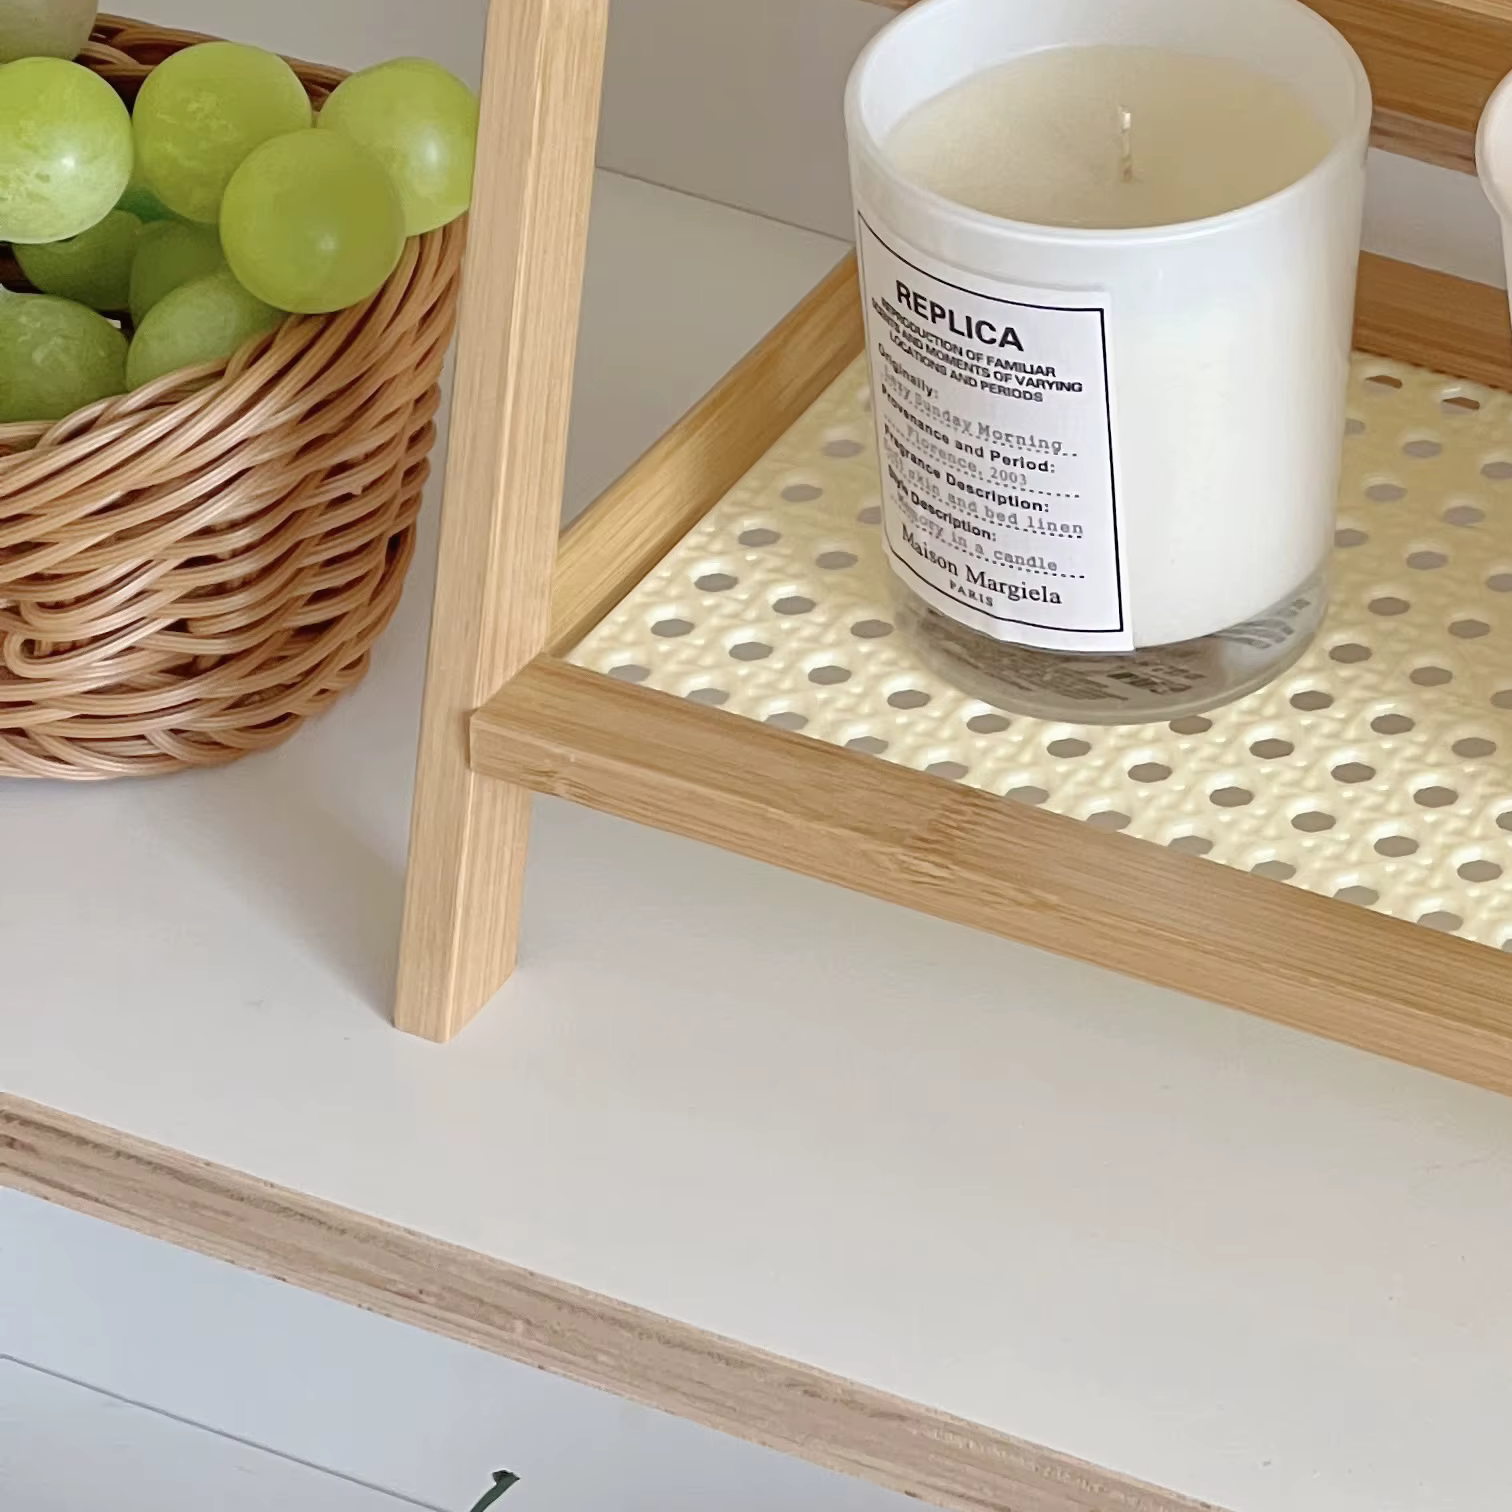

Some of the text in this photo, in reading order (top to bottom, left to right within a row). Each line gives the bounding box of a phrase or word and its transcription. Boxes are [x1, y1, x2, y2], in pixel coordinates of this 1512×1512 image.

[895, 279, 1024, 352] REPLICA
[925, 343, 991, 378] MOMENTS
[993, 370, 1013, 384] OF
[1015, 374, 1083, 393] VARYING
[965, 348, 985, 363] OF
[986, 355, 1057, 378] FAMILIAR
[949, 369, 978, 388] AND
[980, 380, 1044, 403] PERIODS
[978, 421, 1063, 455] Morning
[955, 439, 984, 458] and
[990, 449, 1055, 474] Period:
[946, 472, 1049, 513] Description:
[990, 466, 1028, 486] 2003
[910, 490, 997, 542] Description:
[948, 492, 978, 513] and
[984, 505, 1018, 526] bed
[1027, 515, 1083, 534] linen
[902, 522, 1062, 604] Maison Margiela
[993, 549, 1058, 572] candle
[950, 579, 994, 607] PARIS
